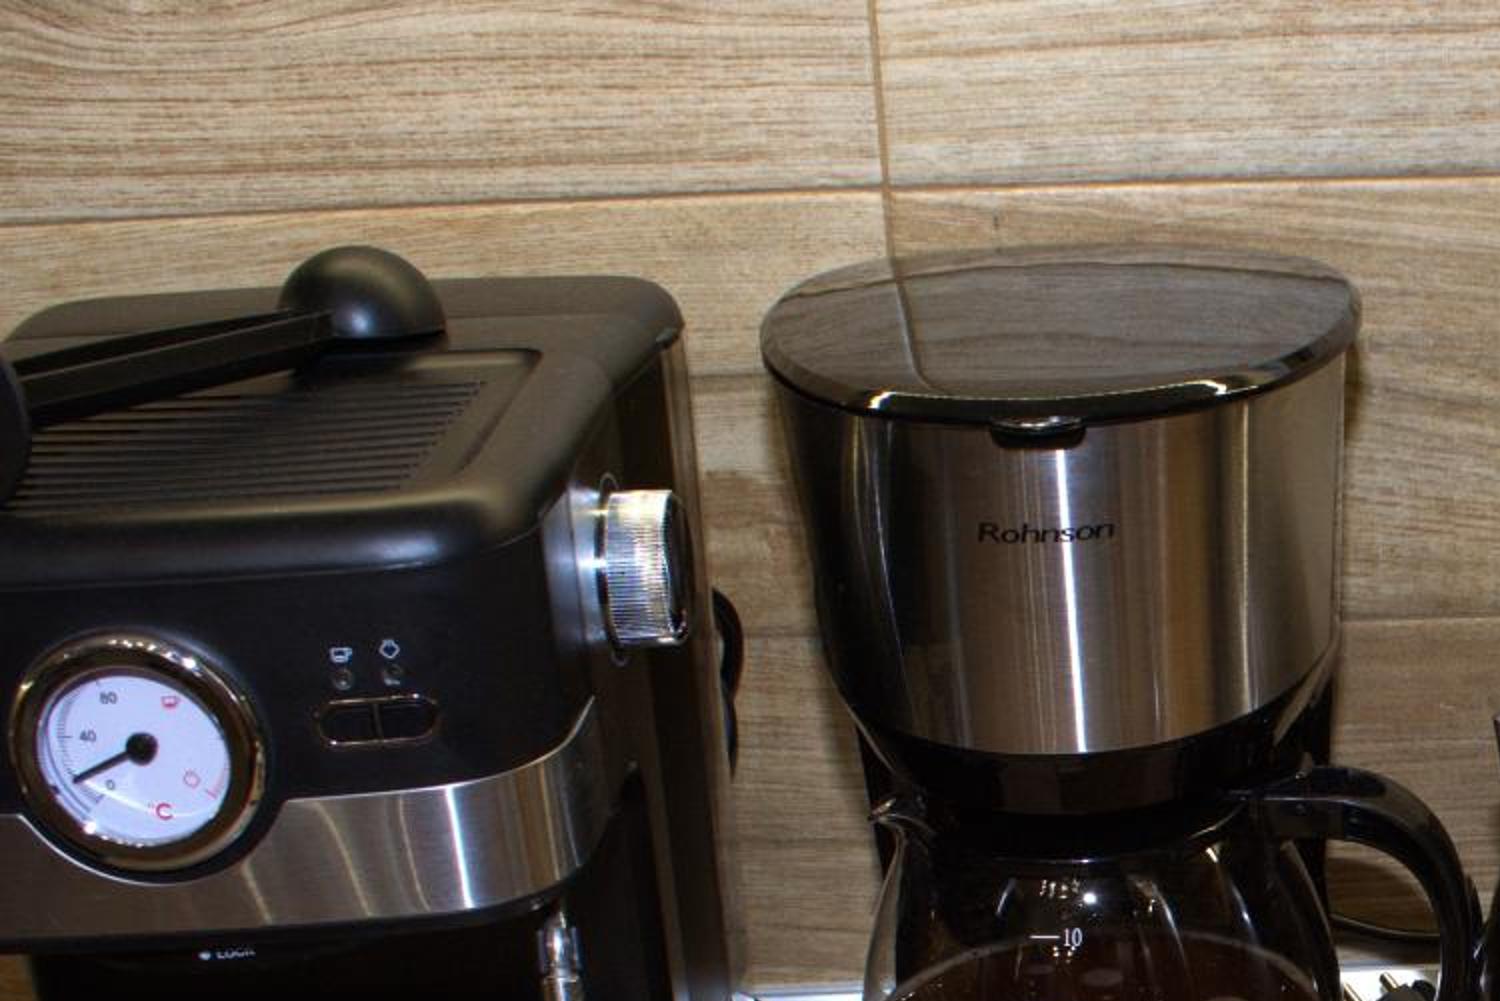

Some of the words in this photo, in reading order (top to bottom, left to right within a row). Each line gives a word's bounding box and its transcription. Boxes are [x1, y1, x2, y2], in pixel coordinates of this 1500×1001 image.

[977, 522, 1115, 544] Rohnson
[99, 691, 118, 705] 80
[79, 729, 97, 743] 40
[105, 779, 116, 791] 0
[1063, 928, 1083, 947] 10
